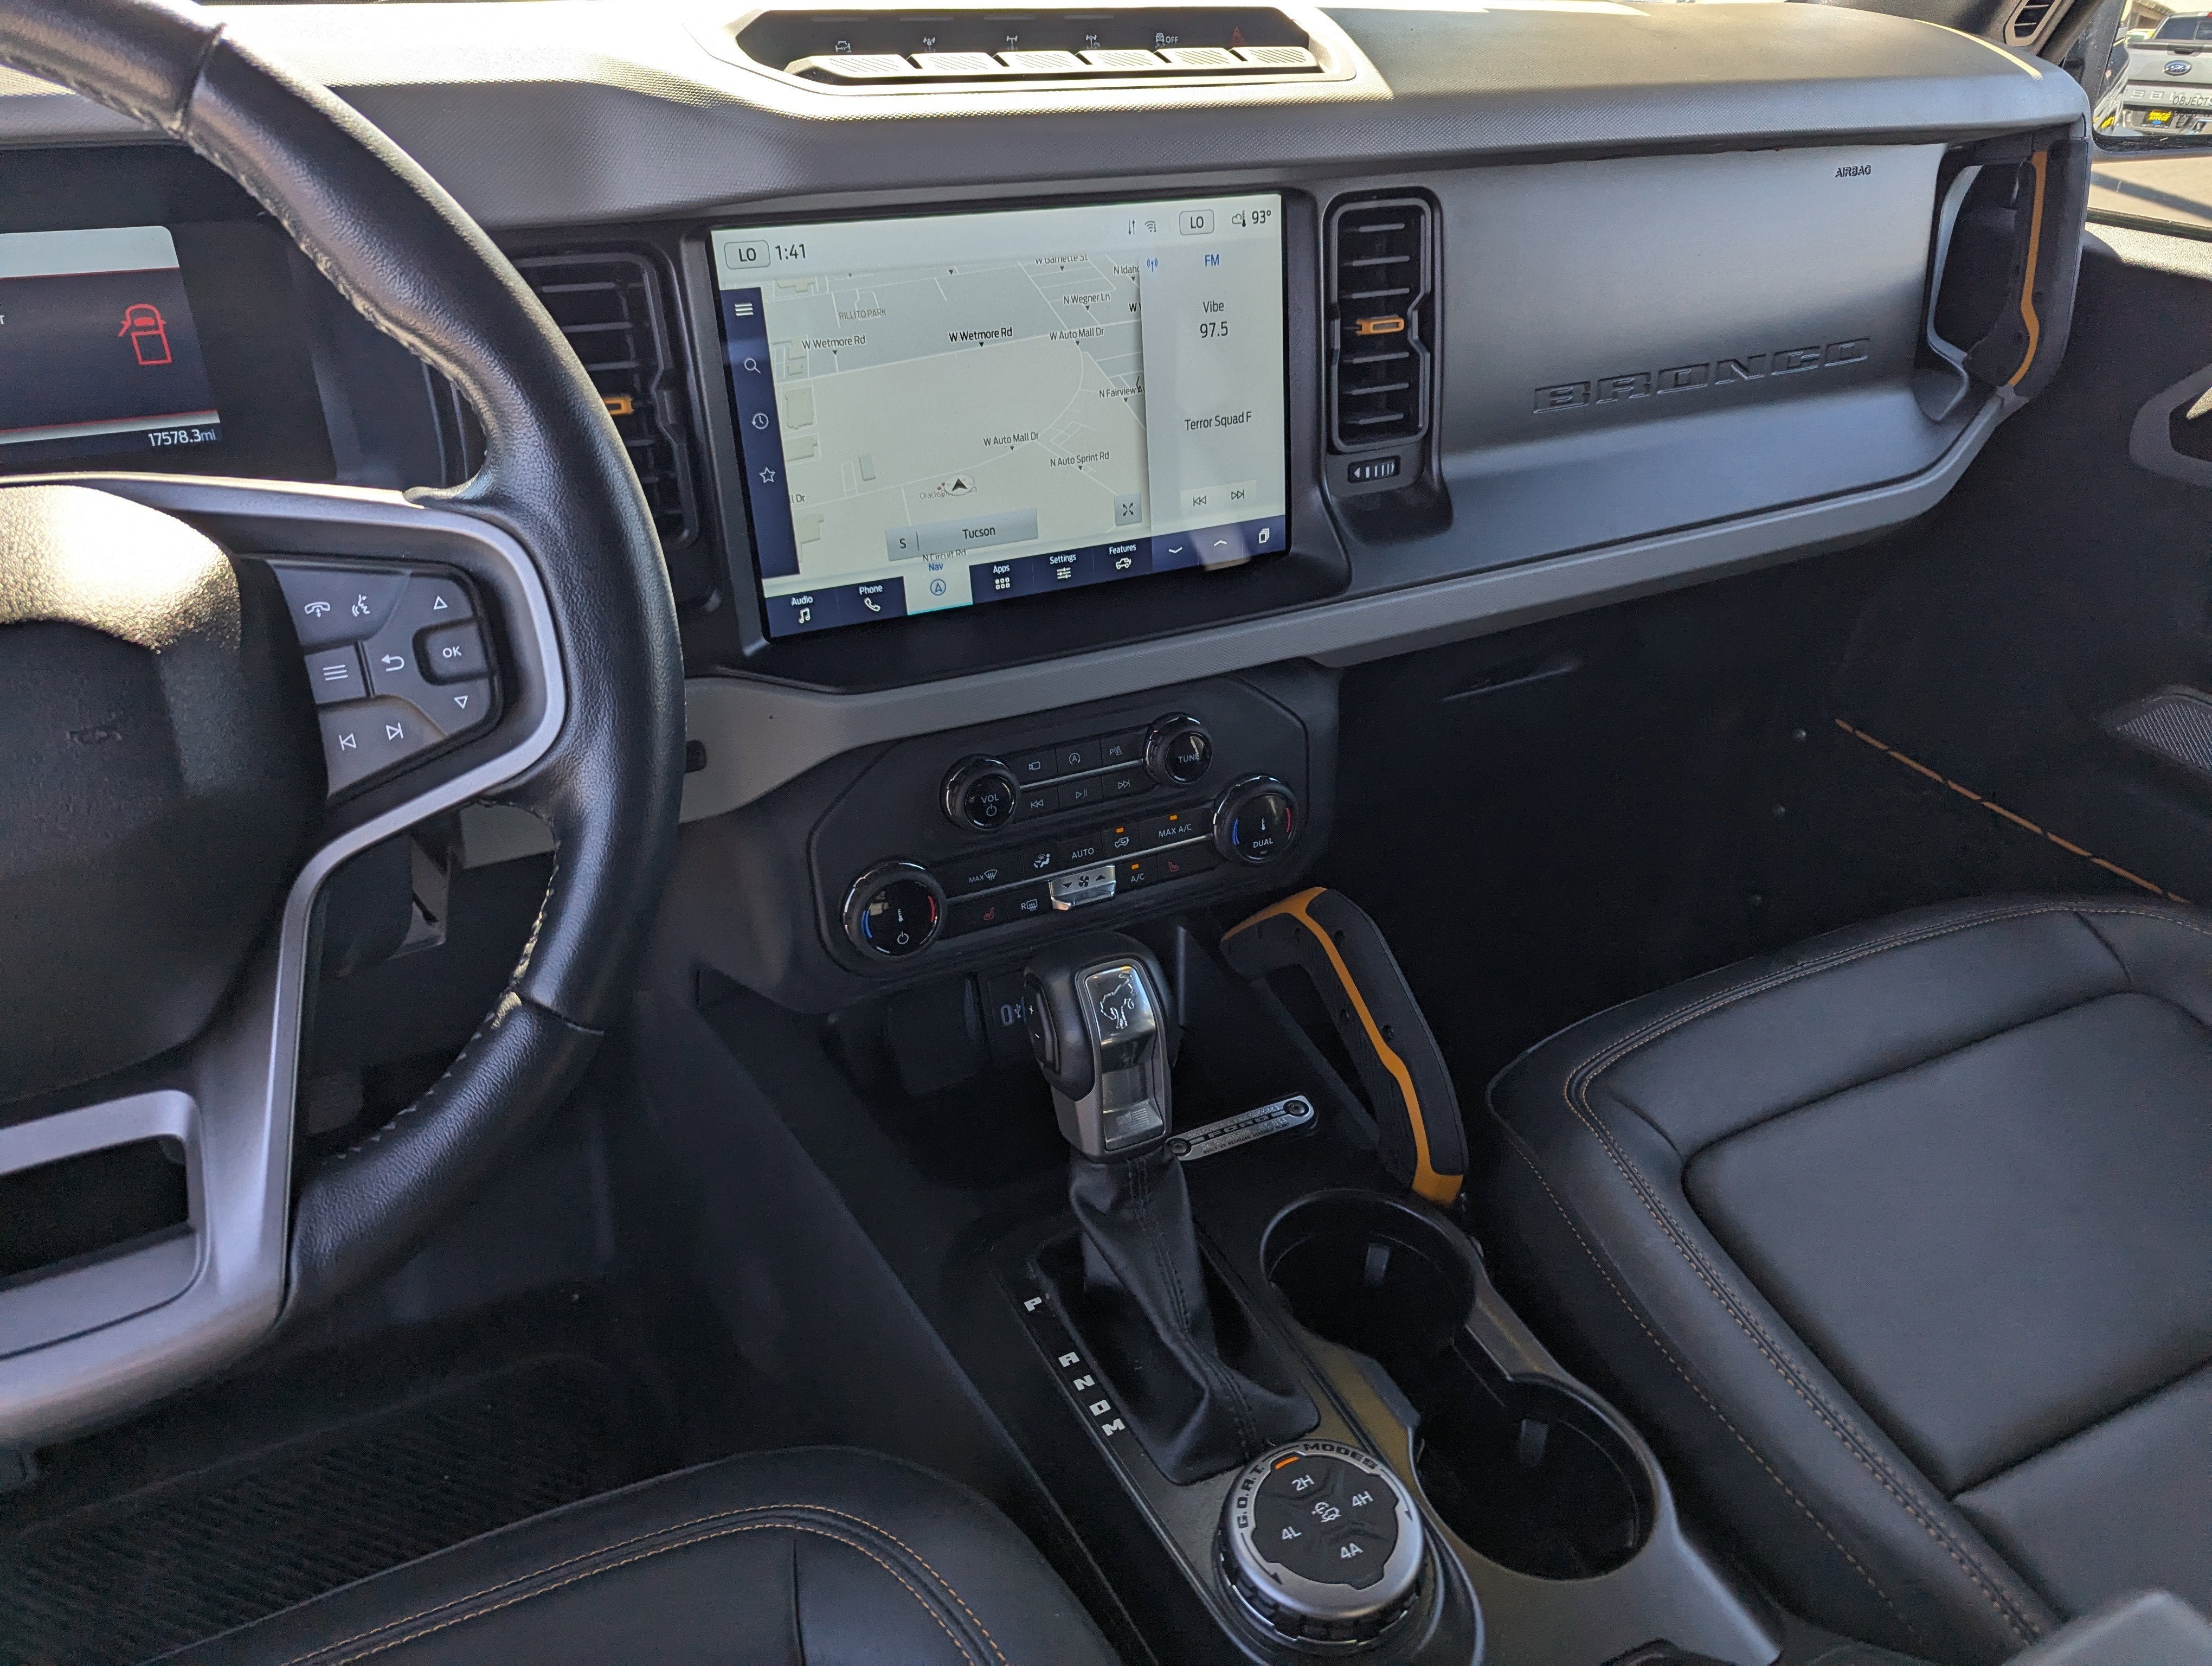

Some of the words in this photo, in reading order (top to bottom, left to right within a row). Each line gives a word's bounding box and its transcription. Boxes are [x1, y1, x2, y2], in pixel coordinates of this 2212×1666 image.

[1835, 165, 1872, 177] AIRBAG
[1190, 216, 1204, 229] LO
[1252, 210, 1271, 224] 93°
[738, 248, 756, 261] LO
[775, 244, 806, 260] 1:41
[1205, 254, 1219, 267] FM
[1114, 266, 1119, 274] N
[1064, 296, 1070, 305] N
[1071, 295, 1099, 305] Wegner
[1101, 293, 1110, 302] Ln
[1203, 300, 1224, 313] Vibe
[839, 311, 866, 320] RILLITO
[867, 308, 887, 318] PARK
[949, 332, 958, 342] W
[960, 330, 999, 341] Wetmore
[1001, 327, 1012, 337] Rd
[1050, 332, 1058, 341] W
[1059, 330, 1077, 339] Auto
[1078, 328, 1094, 338] Mall
[1095, 328, 1104, 336] Dr
[1200, 321, 1228, 338] 97.5
[802, 340, 811, 349] W
[813, 337, 853, 348] Wetmore
[854, 335, 866, 345] Rd
[1533, 337, 1870, 414] BRONCO
[1099, 390, 1104, 398] N
[1106, 387, 1136, 398] Fairview
[1185, 415, 1212, 431] Terror
[1214, 413, 1244, 428] Squad
[1246, 412, 1252, 422] F
[983, 437, 992, 446] W
[993, 435, 1012, 445] Auto
[1013, 433, 1029, 443] Mall
[1031, 432, 1039, 440] Dr
[1050, 459, 1056, 467] N
[1057, 456, 1075, 466] Auto
[1076, 452, 1099, 465] Sprint
[1100, 451, 1109, 460] Rd
[796, 494, 805, 503] Dr
[899, 539, 906, 549] S
[962, 526, 995, 540] Tucson
[956, 548, 966, 556] Rd
[1109, 543, 1136, 555] Features
[1050, 552, 1077, 565] Settings
[929, 563, 943, 572] Nav
[993, 564, 1010, 575] Apps
[859, 585, 883, 594] Phone
[791, 596, 813, 606] Audio
[442, 646, 461, 658] OK
[1178, 752, 1199, 764] TUNE
[981, 793, 999, 804] VOL
[1159, 826, 1176, 838] MAX
[1178, 823, 1192, 833] A/C
[1253, 837, 1274, 848] DUAL
[1071, 847, 1095, 860] AUTO
[969, 874, 983, 883] MAX
[1130, 873, 1144, 882] A/C
[1024, 1297, 1042, 1311] P
[1073, 1375, 1095, 1391] N
[1089, 1400, 1111, 1416] D
[1102, 1418, 1126, 1436] M
[1303, 1443, 1378, 1469] MODES
[1291, 1474, 1315, 1491] 2H
[1352, 1491, 1373, 1507] 4H
[1281, 1526, 1302, 1541] 4L
[1340, 1542, 1363, 1559] 4A
